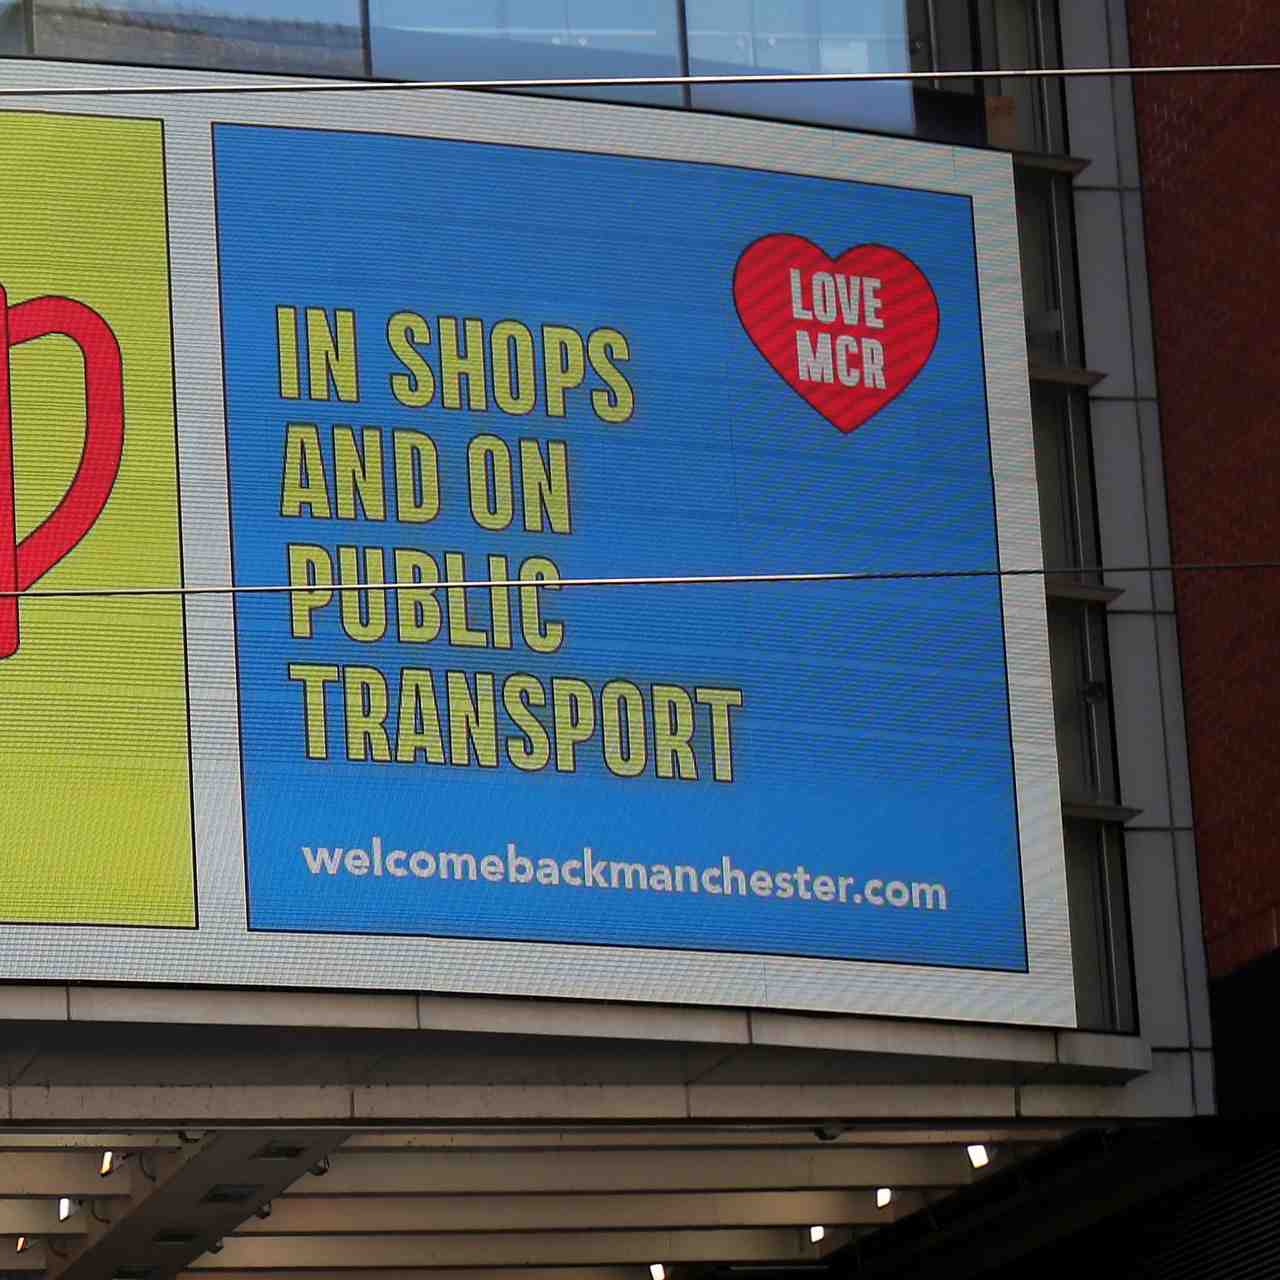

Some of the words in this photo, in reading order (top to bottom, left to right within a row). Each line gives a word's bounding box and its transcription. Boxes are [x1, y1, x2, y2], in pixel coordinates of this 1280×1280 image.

[790, 267, 884, 330] LOVE
[276, 305, 360, 403] IN
[386, 311, 635, 424] SHOPS
[796, 331, 886, 390] MCR
[280, 422, 440, 524] AND
[466, 434, 573, 534] ON
[287, 543, 565, 654] PUBLIC
[287, 662, 744, 783] TRANSPORT
[303, 836, 948, 911] welcomebackmanchester.com
